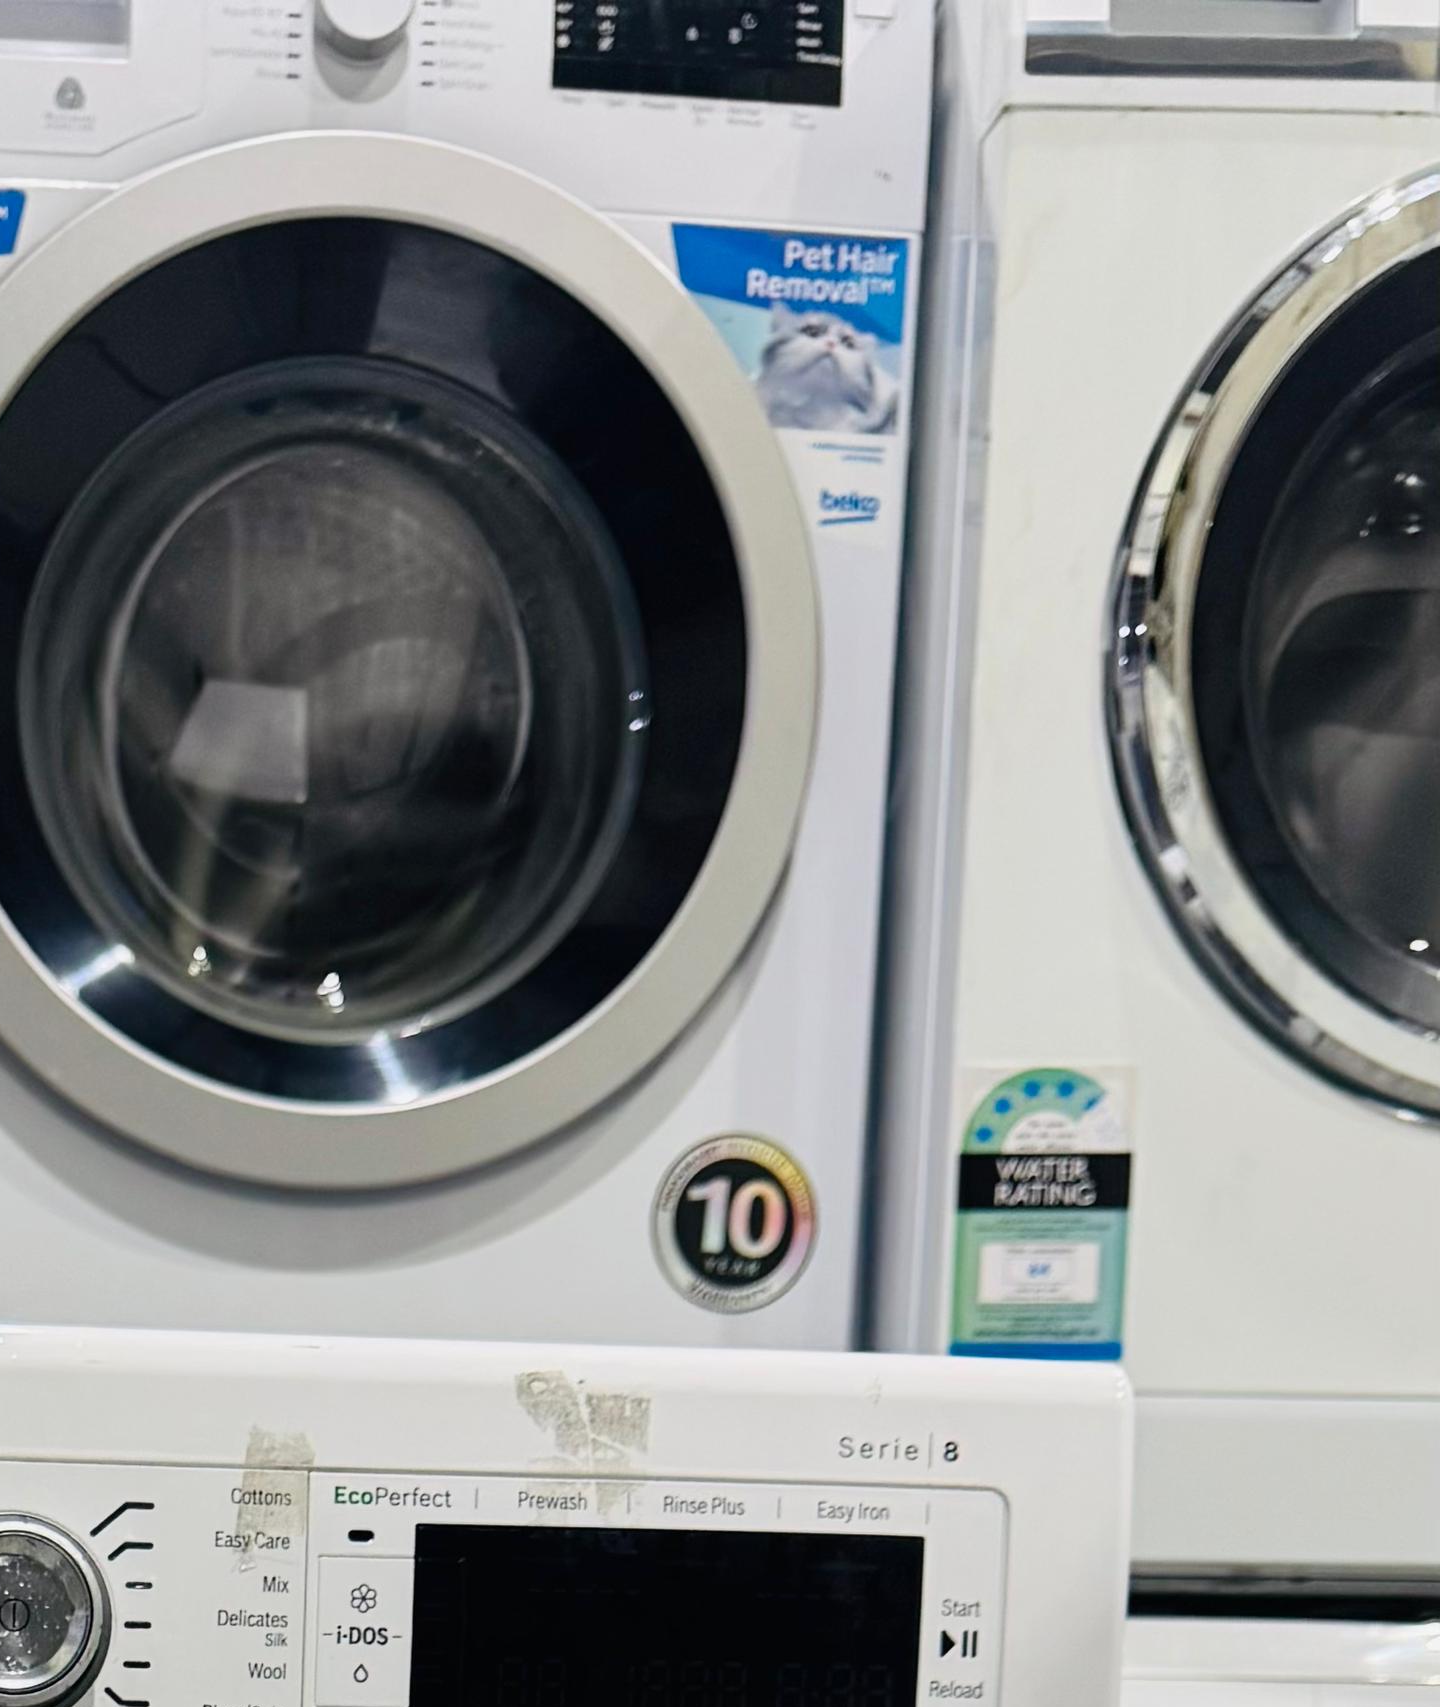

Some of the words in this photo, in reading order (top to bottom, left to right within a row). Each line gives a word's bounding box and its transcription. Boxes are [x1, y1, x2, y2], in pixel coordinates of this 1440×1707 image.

[785, 240, 835, 270] Pet
[838, 244, 899, 275] Hair
[819, 489, 880, 513] beko
[995, 1156, 1091, 1182] WATER
[994, 1180, 1097, 1207] RATING
[687, 1176, 787, 1259] 10
[839, 1436, 920, 1462] Serie
[944, 1441, 959, 1462] 8
[231, 1488, 292, 1506] Cottons
[334, 1486, 452, 1508] EcoPerfect
[518, 1490, 588, 1511] Prewash
[663, 1495, 708, 1514] Rinse
[712, 1497, 746, 1516] Plus
[817, 1501, 854, 1523] Easy
[858, 1503, 890, 1521] Iron
[215, 1531, 251, 1552] Easy
[254, 1532, 290, 1549] Care
[263, 1576, 289, 1593] Mix
[941, 1598, 981, 1617] Start
[217, 1609, 288, 1628] Delicates
[265, 1632, 288, 1647] Silk
[336, 1625, 388, 1645] i-DOS
[248, 1662, 287, 1679] Wool
[929, 1680, 984, 1699] Reload
